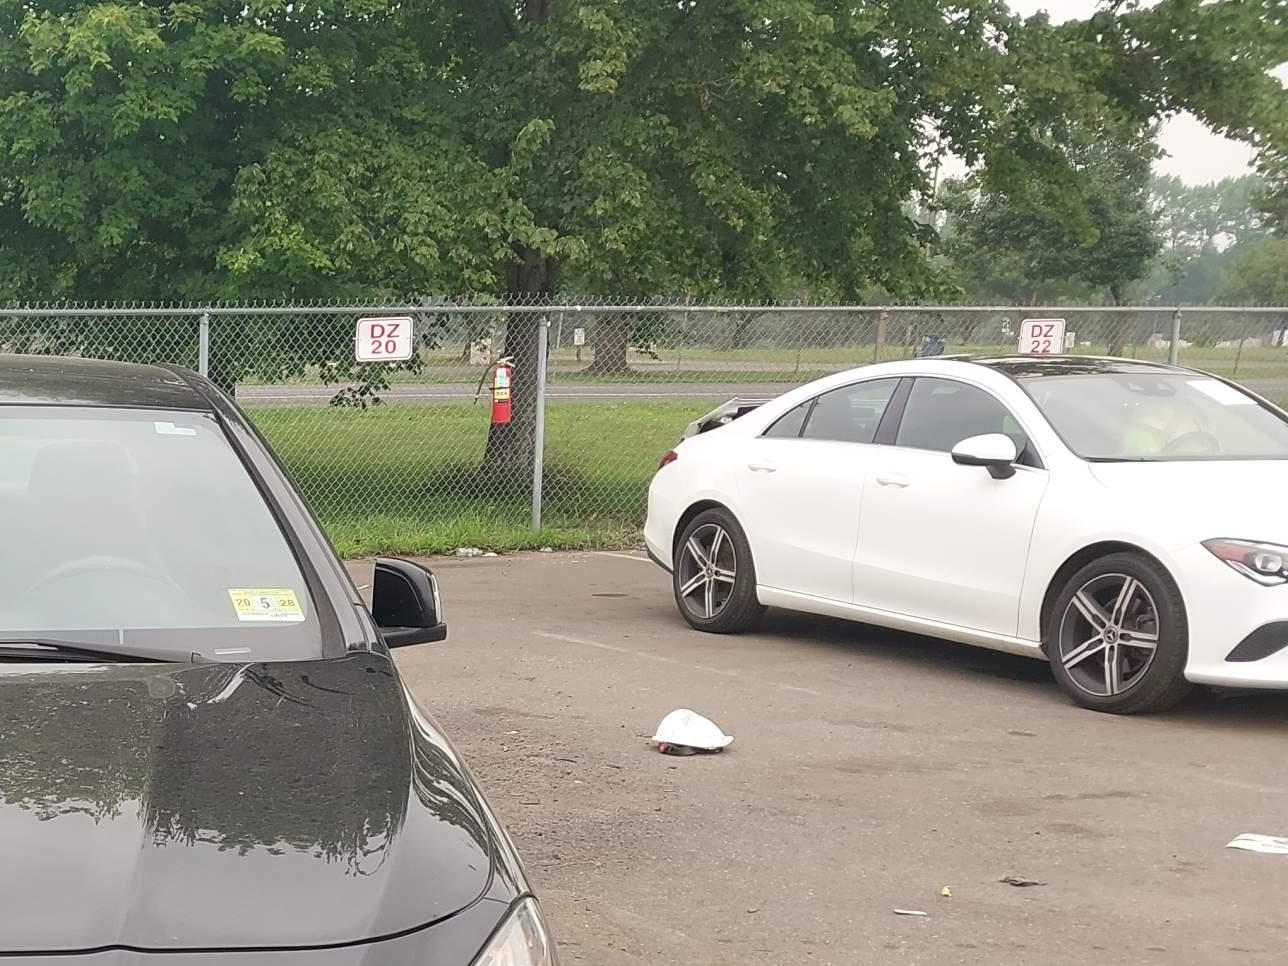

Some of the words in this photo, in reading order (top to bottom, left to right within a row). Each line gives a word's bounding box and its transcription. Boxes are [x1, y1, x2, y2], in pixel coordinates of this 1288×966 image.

[370, 324, 400, 338] DZ
[1031, 324, 1055, 338] DZ
[371, 339, 397, 354] 20
[1030, 339, 1051, 353] 22
[260, 597, 271, 609] 5
